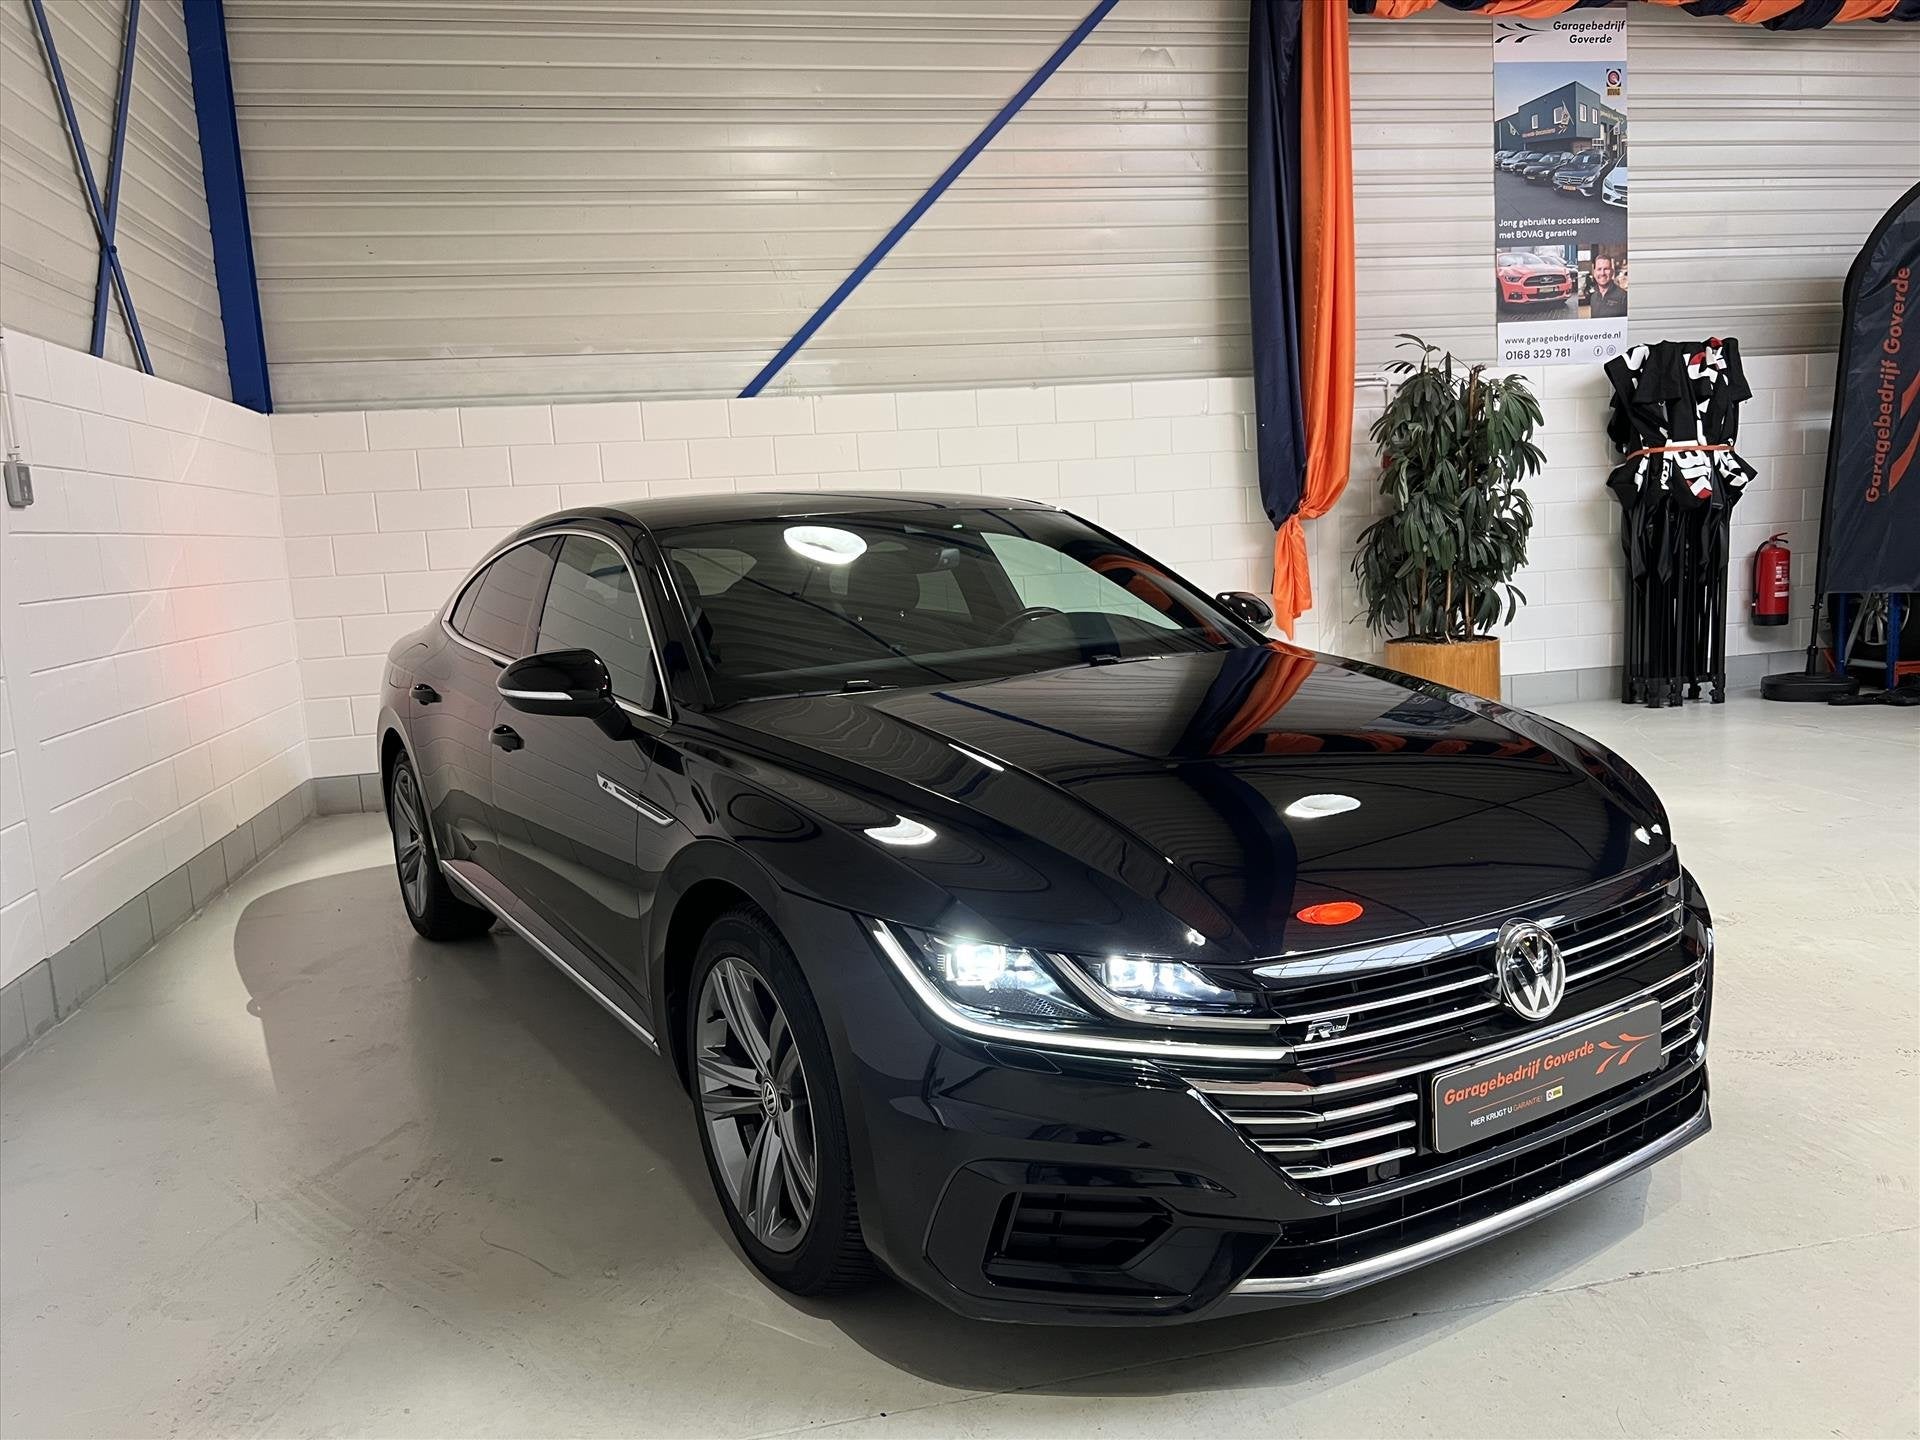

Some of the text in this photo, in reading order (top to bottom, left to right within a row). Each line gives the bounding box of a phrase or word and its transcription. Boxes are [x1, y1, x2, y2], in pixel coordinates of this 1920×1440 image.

[1553, 20, 1626, 32] Garagebedrijf
[1569, 34, 1613, 43] Goverde
[1498, 216, 1600, 228] Jong gebruikte occassions
[1499, 229, 1577, 239] met BOVAG garantie
[1505, 331, 1621, 345] www.garagebedrijfgoverde.nl
[1505, 348, 1571, 360] 0168 329 781
[1866, 267, 1911, 503] Garagebedrijf Goverde
[1444, 1041, 1595, 1106] Garagebedrijf Goverde
[1470, 1116, 1486, 1127] HIER
[1507, 1106, 1513, 1114] U
